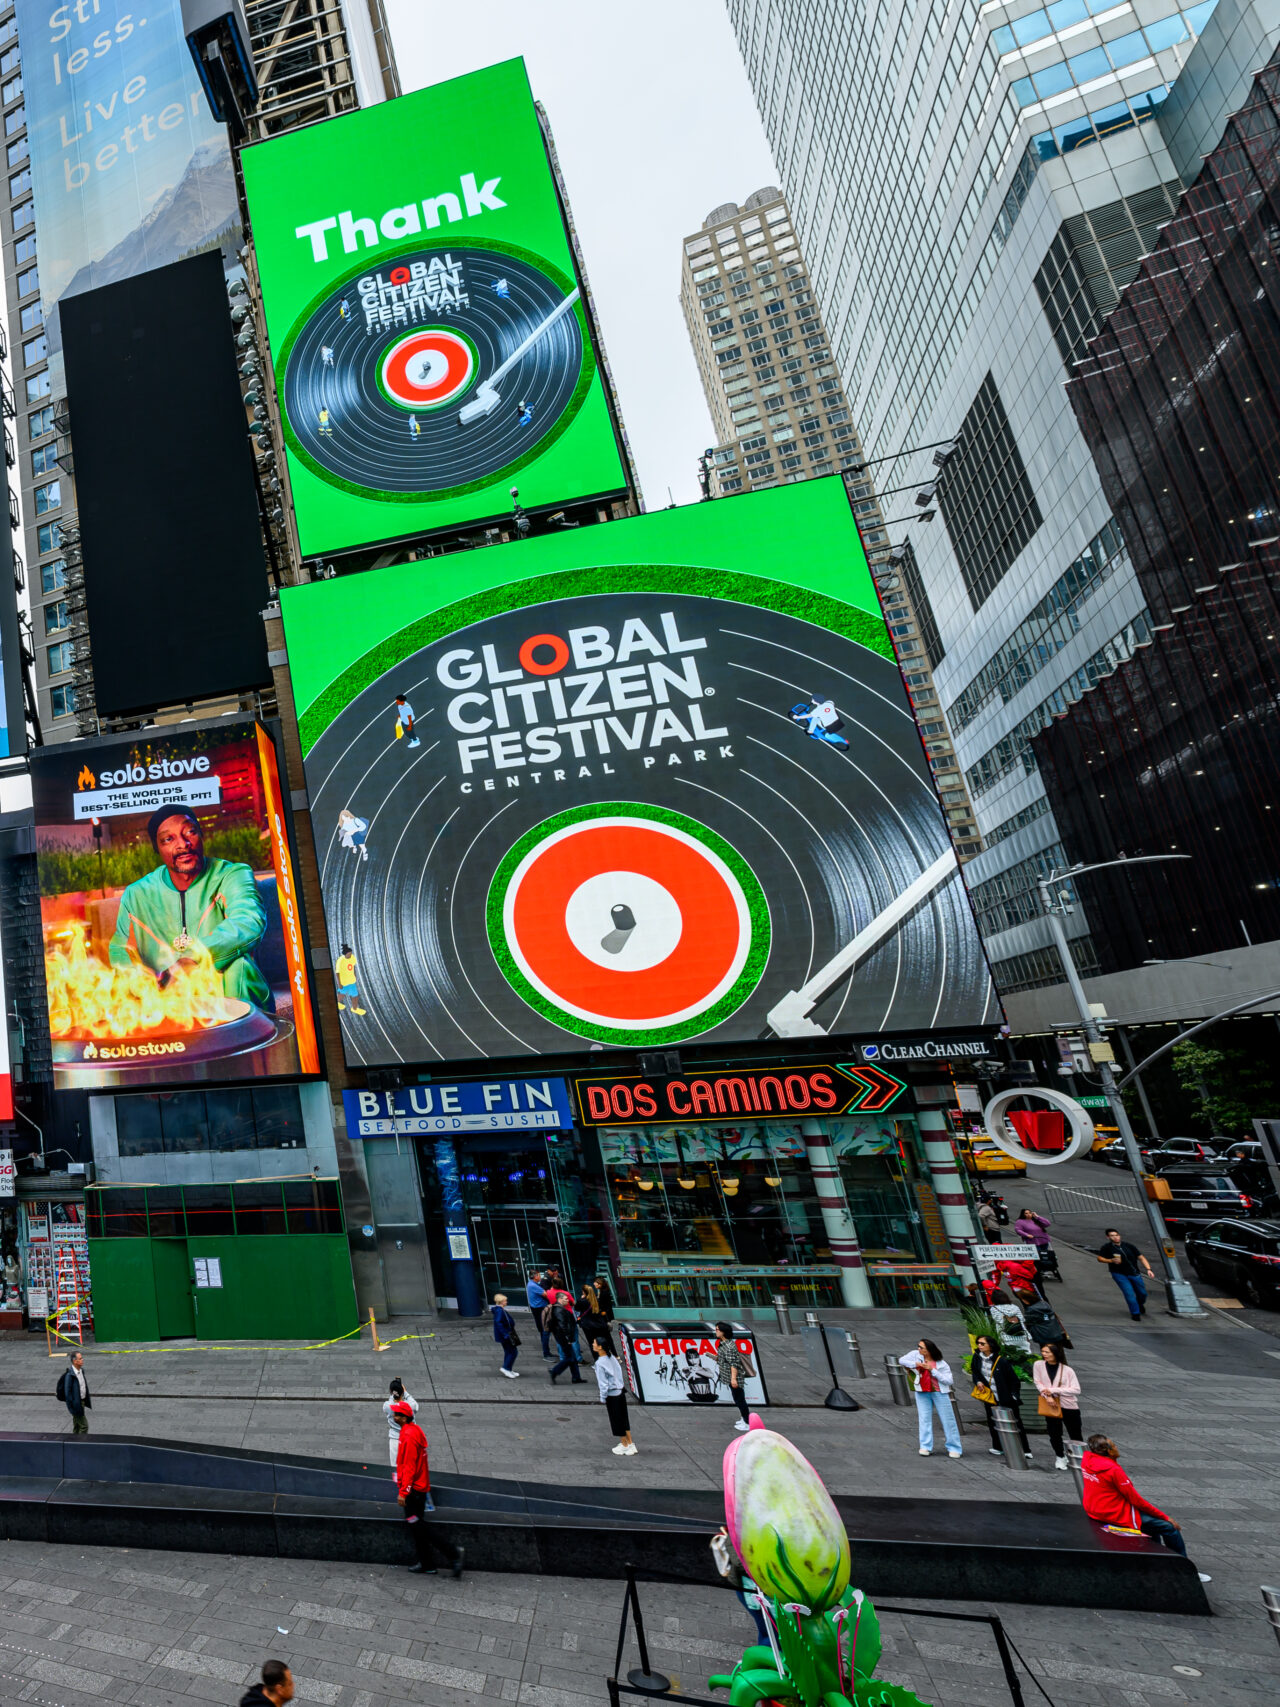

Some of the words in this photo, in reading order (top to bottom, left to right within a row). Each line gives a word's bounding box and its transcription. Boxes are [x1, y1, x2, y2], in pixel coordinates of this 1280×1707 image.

[52, 14, 148, 86] less.
[59, 74, 147, 149] Live
[64, 87, 205, 192] better
[295, 172, 508, 263] Thank
[358, 254, 463, 297] GLOBAL
[365, 286, 469, 328] FESTIVAL
[436, 612, 708, 690] GLOBAL
[457, 703, 729, 774] FESTIVAL
[99, 763, 146, 788] solo
[148, 756, 210, 780] stove
[460, 762, 615, 794] CENTRAL
[644, 745, 735, 769] PARK
[81, 799, 159, 813] BEST-SELLING
[162, 795, 188, 804] FIRE
[190, 791, 212, 800] PIT!
[107, 793, 129, 802] THE
[131, 786, 183, 799] WORLD'S
[275, 813, 290, 895] stove
[287, 898, 300, 963] solo
[100, 1044, 137, 1059] solo
[138, 1041, 186, 1056] stove
[358, 1086, 462, 1118] BLUE
[482, 1081, 553, 1111] FIN
[587, 1083, 658, 1119] DOS
[666, 1073, 837, 1115] CAMINOS
[363, 1118, 461, 1132] SEAFOOD
[490, 1114, 557, 1128] SUSHI
[634, 1338, 753, 1356] CHICAO
